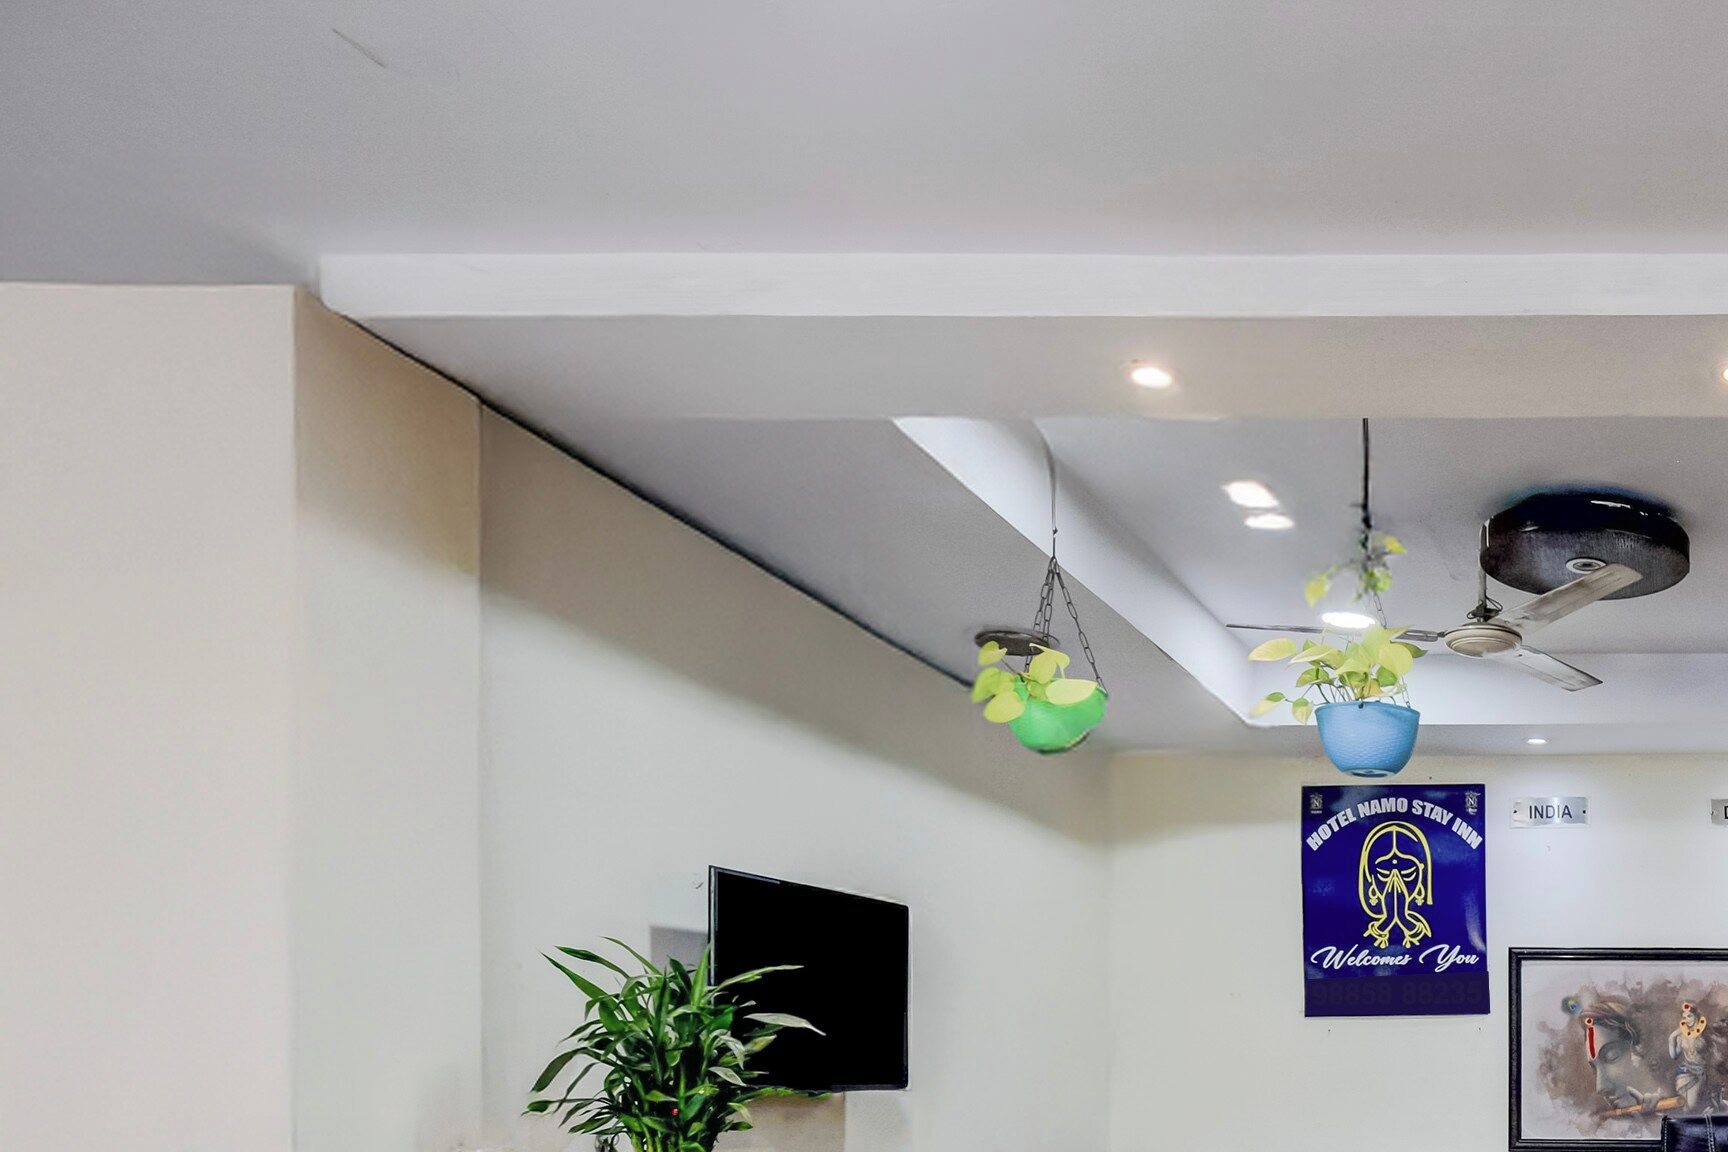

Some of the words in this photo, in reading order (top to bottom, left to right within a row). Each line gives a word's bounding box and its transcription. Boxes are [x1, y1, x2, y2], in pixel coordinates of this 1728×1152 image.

[1306, 808, 1357, 851] HOTEL
[1357, 797, 1408, 818] NAMO
[1412, 799, 1453, 826] STAY
[1451, 818, 1483, 850] INN
[1529, 804, 1573, 819] INDIA
[1310, 944, 1412, 970] Welcomes
[1418, 944, 1479, 973] You
